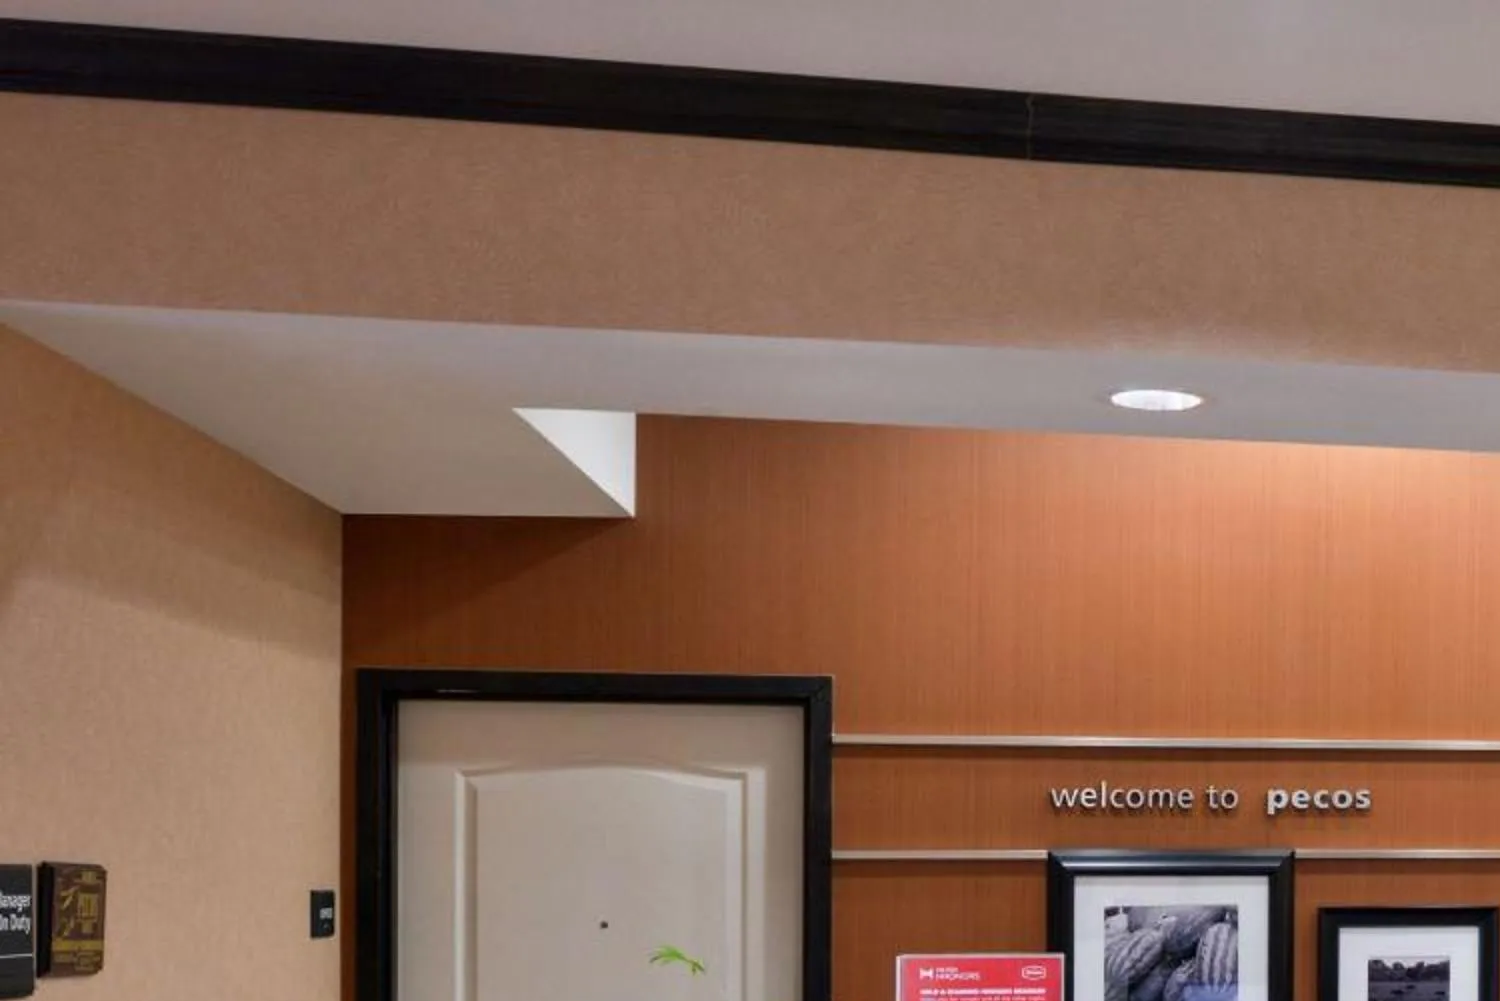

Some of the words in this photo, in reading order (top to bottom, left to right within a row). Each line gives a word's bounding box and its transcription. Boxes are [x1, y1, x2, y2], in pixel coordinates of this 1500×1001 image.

[1050, 780, 1194, 810] welcome
[1206, 785, 1239, 809] to
[1266, 787, 1372, 815] pecos
[9, 912, 31, 935] Duty
